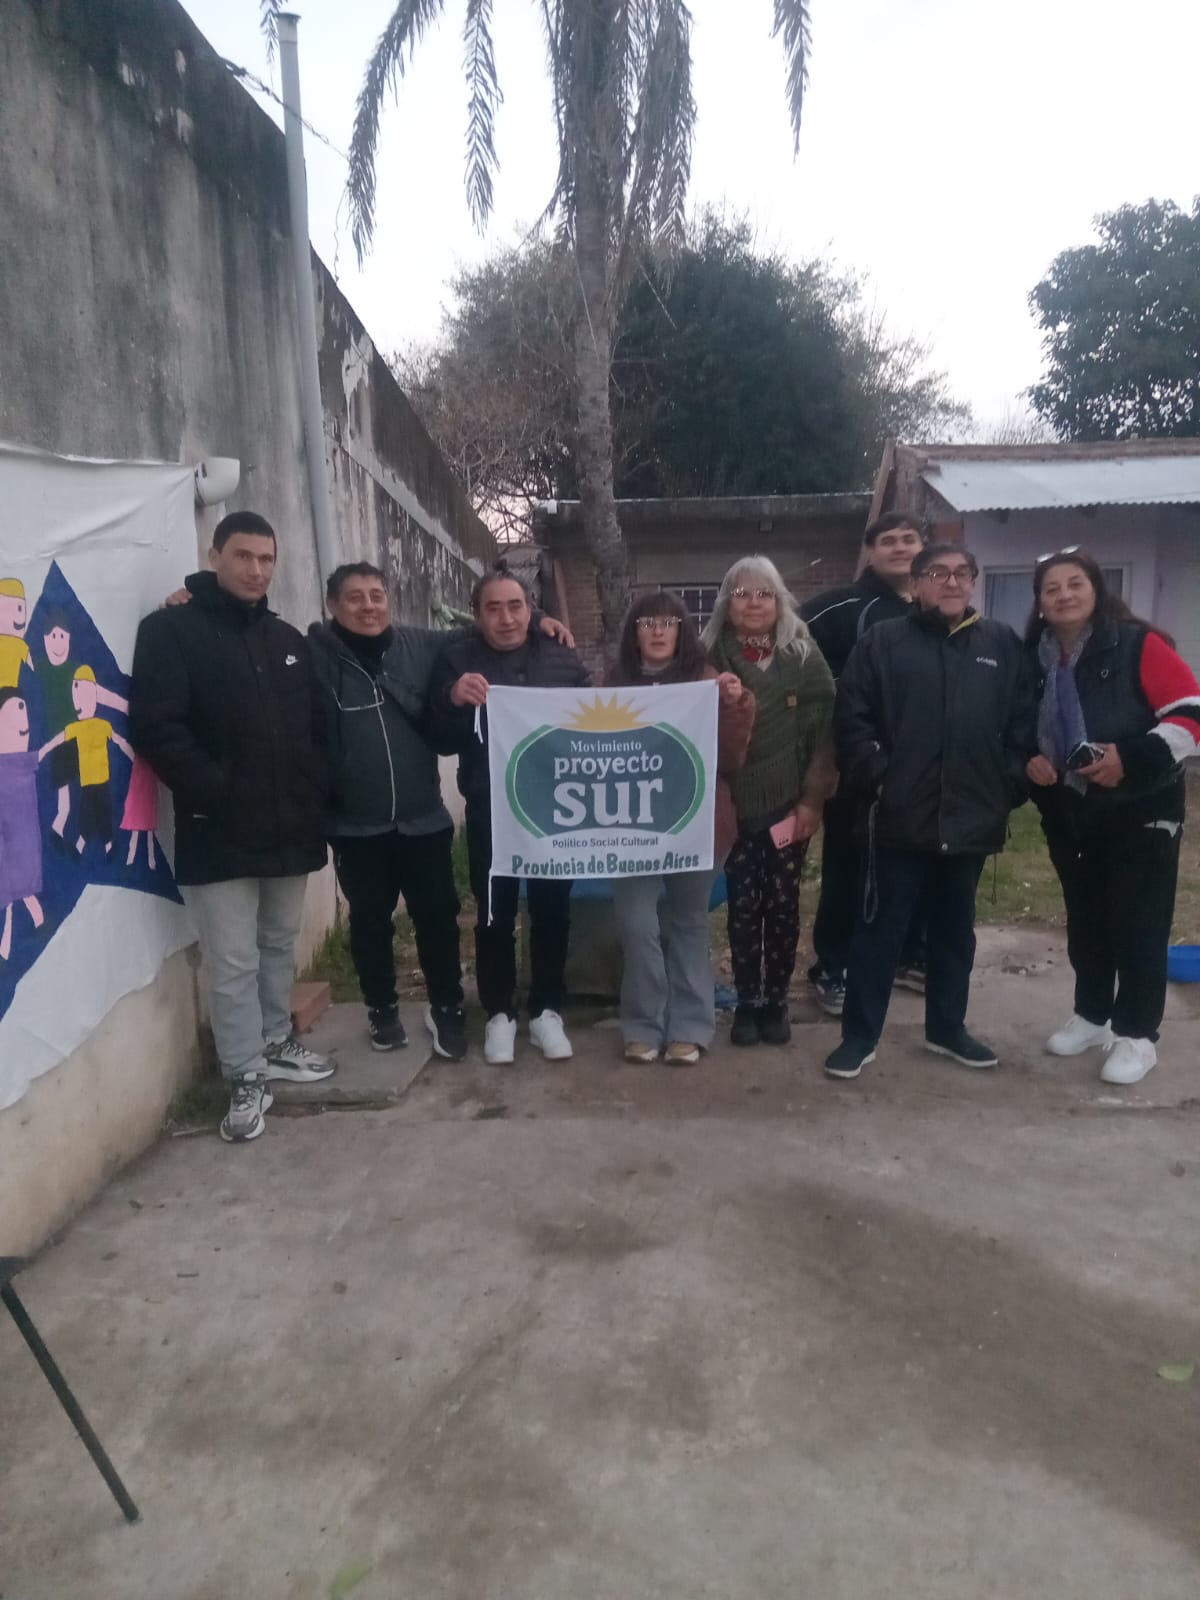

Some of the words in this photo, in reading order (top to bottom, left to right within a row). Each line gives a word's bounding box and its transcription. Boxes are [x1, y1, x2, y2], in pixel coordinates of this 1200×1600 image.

[570, 740, 642, 752] Movimiento
[554, 751, 663, 780] proyecto
[553, 778, 663, 827] sur
[590, 836, 619, 847] Social
[621, 836, 659, 847] Cultural
[512, 855, 585, 875] Provincia
[587, 854, 604, 874] de
[606, 853, 660, 873] Buenos
[662, 851, 699, 870] Aires
